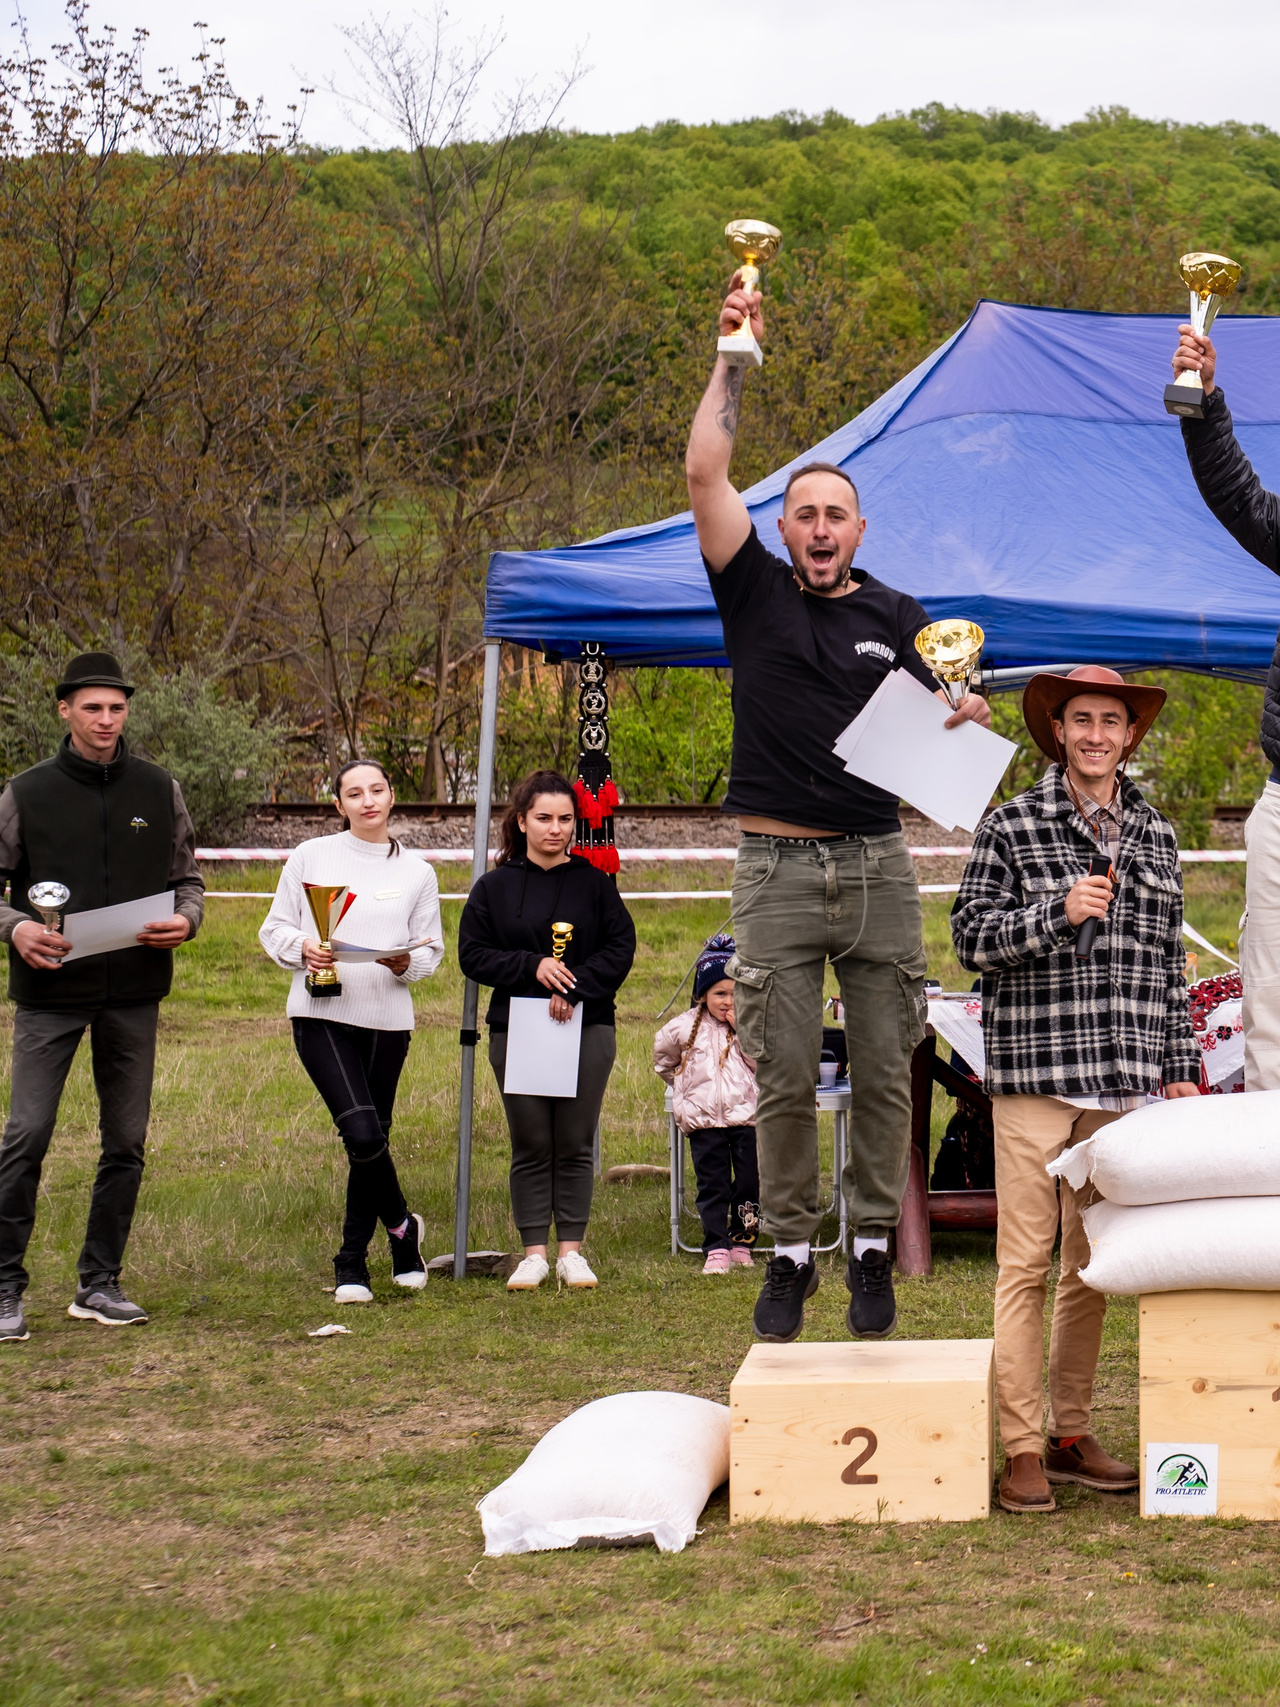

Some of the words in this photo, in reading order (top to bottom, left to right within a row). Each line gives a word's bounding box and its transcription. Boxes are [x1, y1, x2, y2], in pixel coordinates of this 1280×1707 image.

[854, 641, 896, 663] TOMORROW
[841, 1427, 878, 1485] 2
[1155, 1487, 1172, 1495] PRO
[1171, 1488, 1207, 1496] ATLETIC
